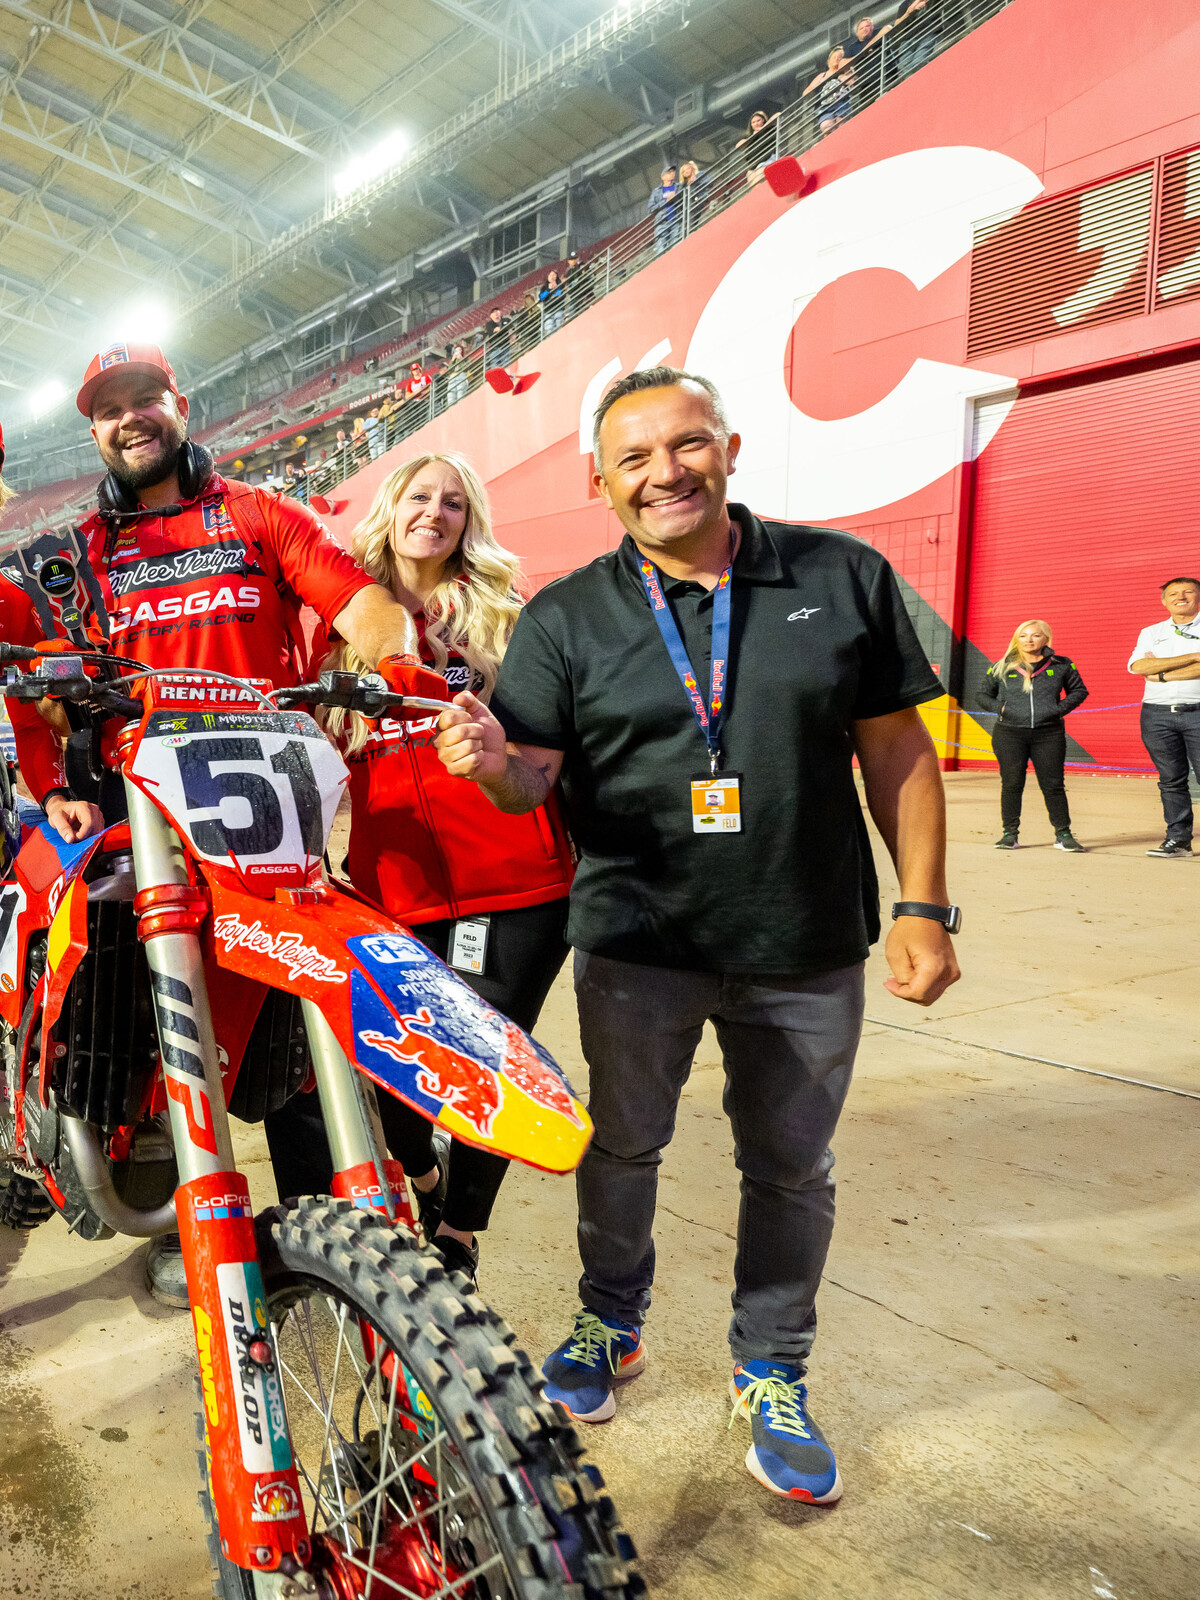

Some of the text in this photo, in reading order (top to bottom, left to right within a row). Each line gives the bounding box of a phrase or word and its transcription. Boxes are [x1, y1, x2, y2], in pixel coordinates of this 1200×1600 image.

[349, 396, 371, 409] ROGER
[132, 562, 174, 586] Lee
[174, 549, 247, 578] Designs
[646, 579, 666, 610] Red Bull
[109, 586, 261, 635] GASGAS
[112, 613, 256, 650] FACTORY RACING
[712, 659, 724, 692] Red Bull
[160, 686, 265, 702] RENTHAL
[158, 718, 188, 731] SMX
[690, 695, 710, 727] Red Bull
[350, 742, 407, 764] ACTORY
[175, 738, 324, 856] 51
[250, 866, 297, 874] GASGAS
[214, 913, 348, 983] Troy Lee Designs
[463, 934, 477, 942] FELD
[397, 978, 441, 997] PICTU
[149, 969, 219, 1156] WP
[193, 1195, 250, 1208] GoPro
[265, 1372, 288, 1443] OREX
